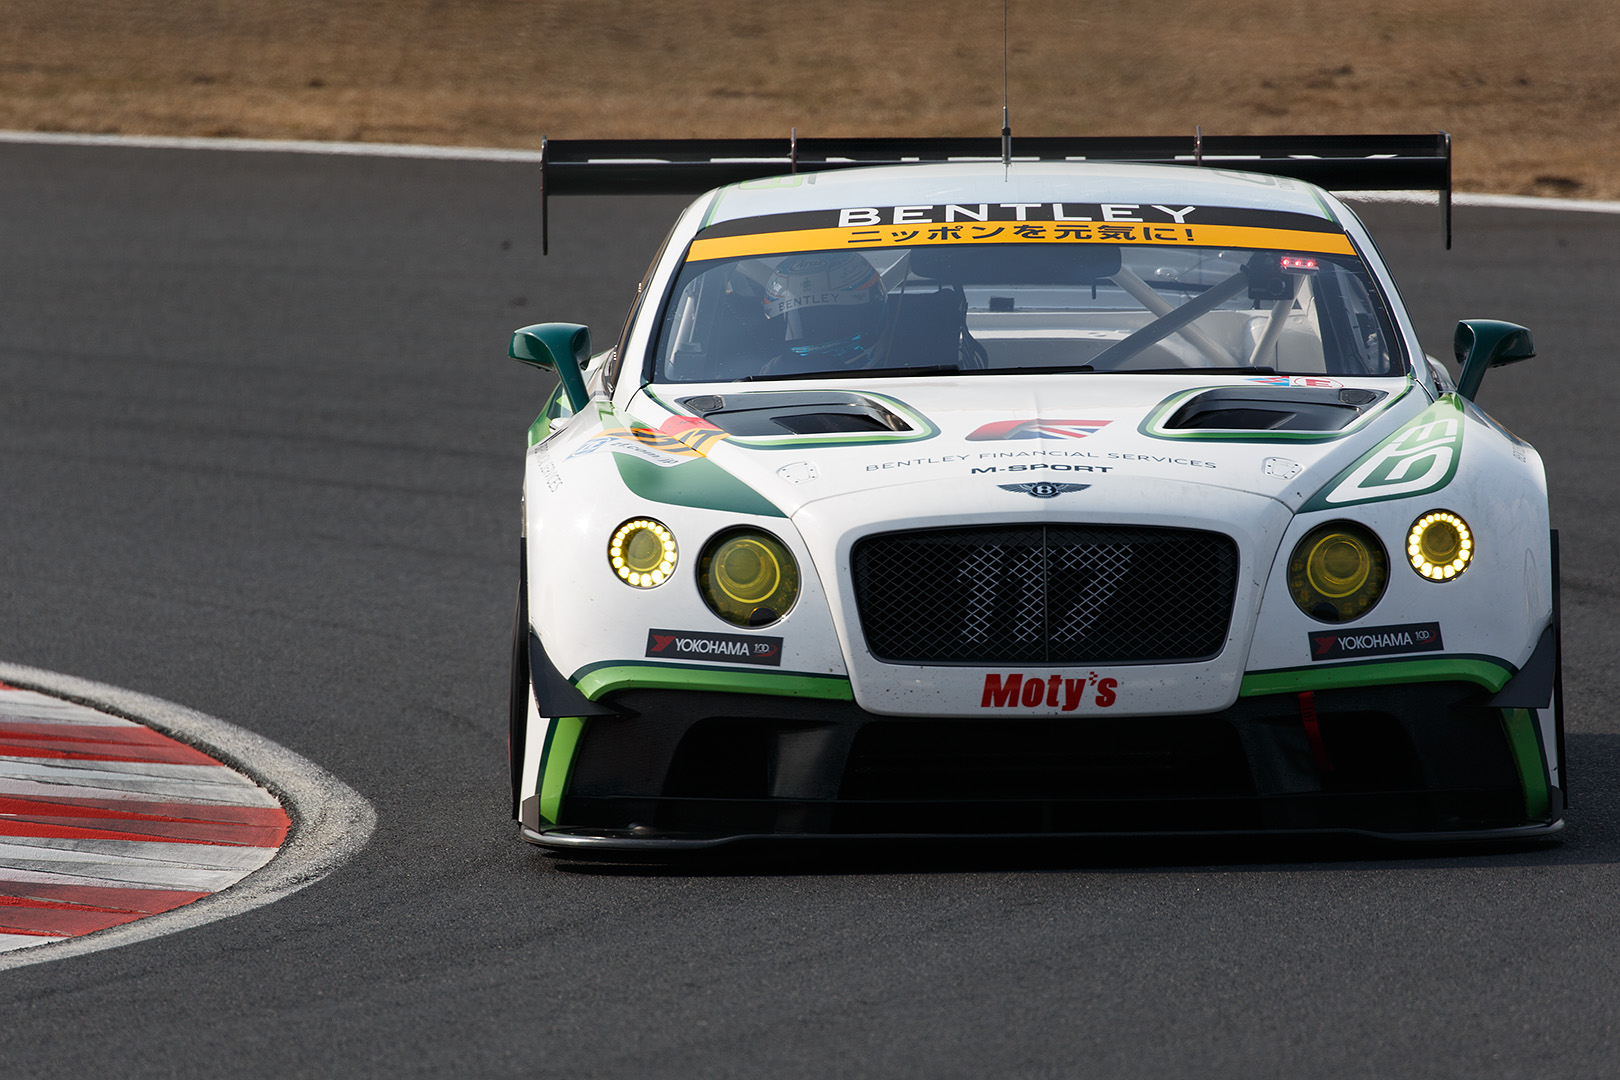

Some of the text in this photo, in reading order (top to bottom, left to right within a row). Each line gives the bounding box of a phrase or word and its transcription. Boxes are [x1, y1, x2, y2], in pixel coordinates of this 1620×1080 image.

[838, 202, 1196, 228] BENTLEY
[847, 224, 1195, 243] ニッポンを元気に!
[778, 292, 840, 312] BENTLEY
[866, 450, 1217, 472] BENTLEY FINANCIAL SERVICES
[971, 463, 1113, 475] M-SPORT
[675, 638, 750, 656] YOKOHAMA
[1337, 631, 1413, 651] YOKOHAMA
[980, 671, 1118, 712] Moty's
